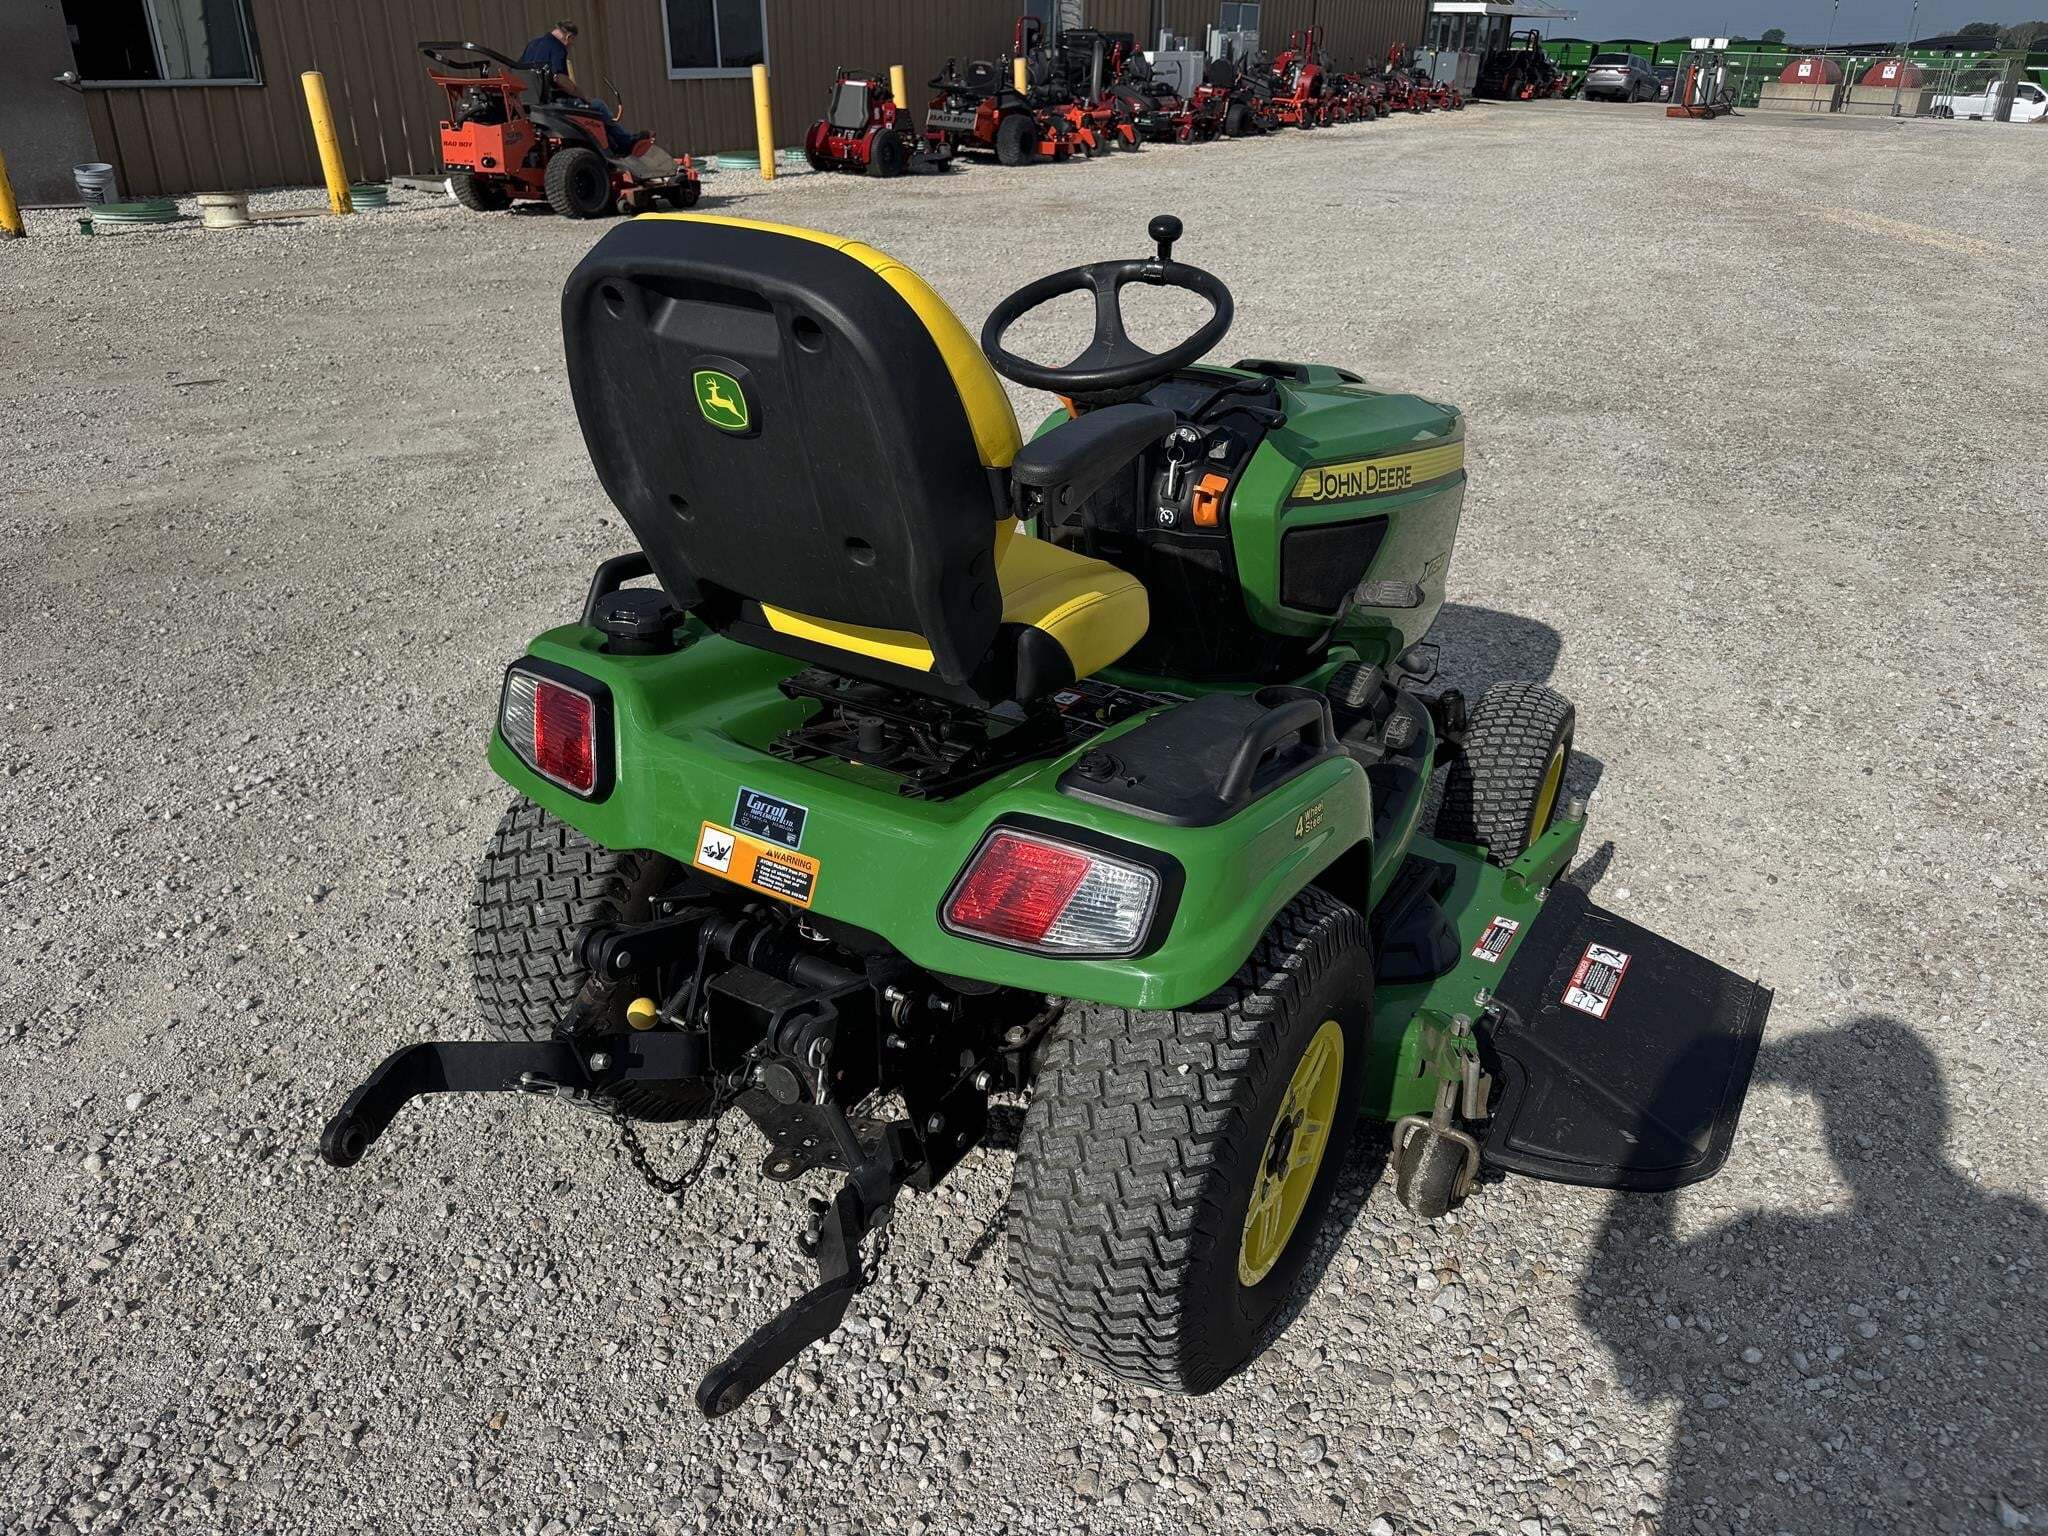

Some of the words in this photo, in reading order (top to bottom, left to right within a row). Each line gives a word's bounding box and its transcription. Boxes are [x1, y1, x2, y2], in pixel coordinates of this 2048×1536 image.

[1312, 470, 1362, 497] JOHN
[1366, 465, 1412, 490] DEERE
[746, 793, 788, 823] Carroll
[1295, 816, 1304, 837] 4
[1304, 800, 1323, 822] Wheel
[1304, 812, 1324, 833] Steer
[773, 851, 812, 871] WARNING
